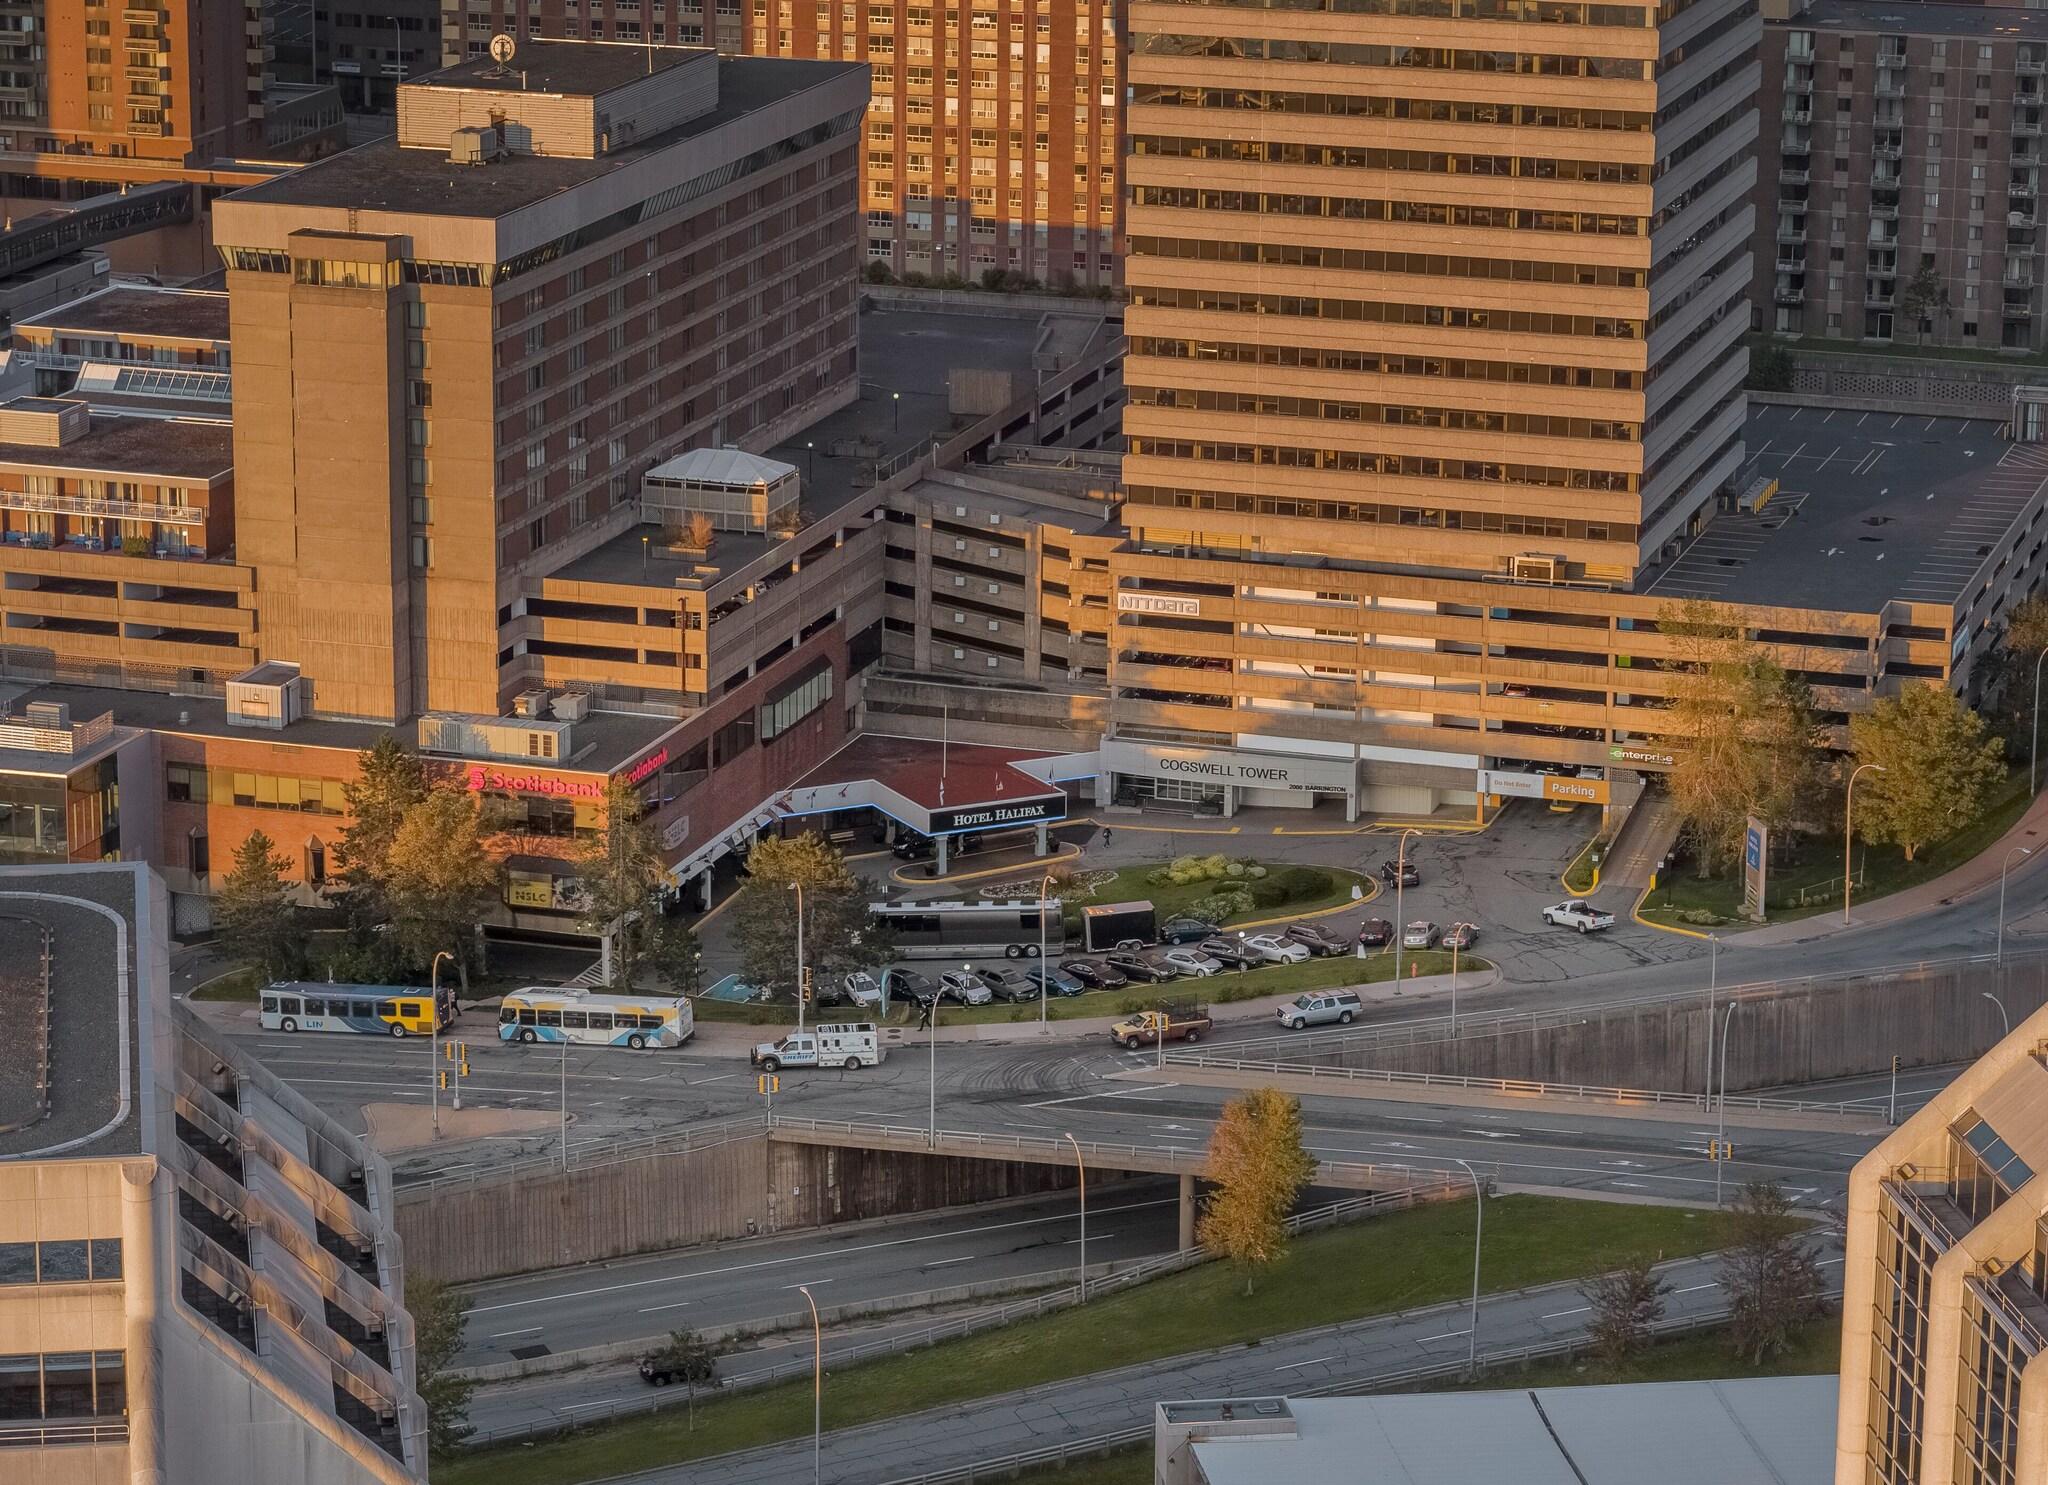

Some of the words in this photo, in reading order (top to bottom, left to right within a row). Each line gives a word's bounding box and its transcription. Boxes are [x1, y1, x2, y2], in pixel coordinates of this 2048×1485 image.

[1160, 758, 1234, 777] COGSWELL
[1238, 766, 1288, 780] TOWER
[492, 773, 604, 797] Scotiabank
[1552, 783, 1595, 798] Parking
[953, 812, 993, 826] HOTEL
[995, 805, 1045, 820] HALIFAX
[515, 891, 547, 903] NSLC
